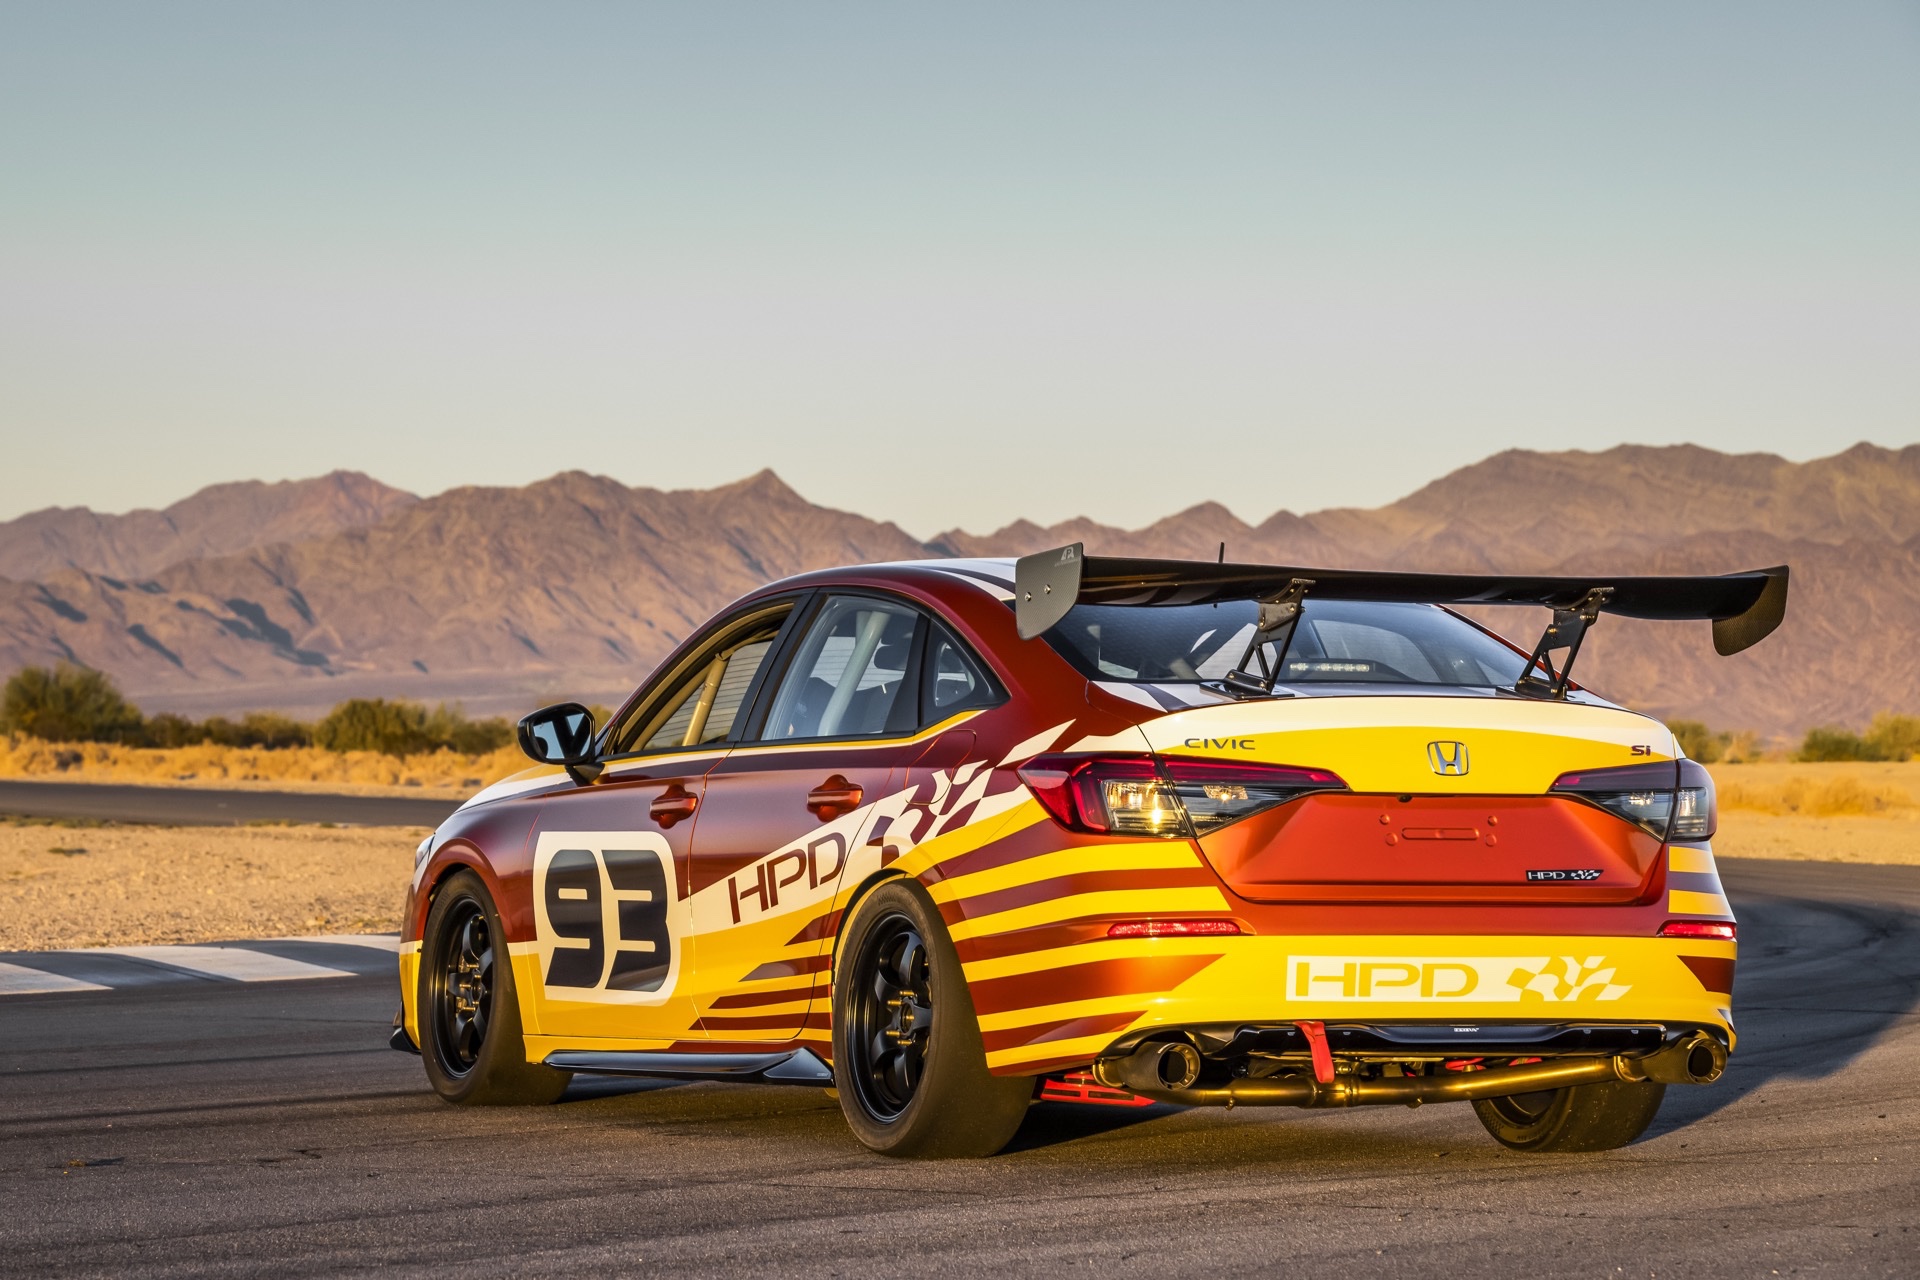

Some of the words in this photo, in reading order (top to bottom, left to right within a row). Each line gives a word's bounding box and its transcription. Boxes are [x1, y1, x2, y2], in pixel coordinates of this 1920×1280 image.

[1184, 738, 1256, 750] CIVIC
[1631, 745, 1651, 756] Si
[727, 832, 846, 925] HPD
[1527, 871, 1566, 880] HPD
[545, 849, 671, 992] 93
[1295, 962, 1479, 998] HPD
